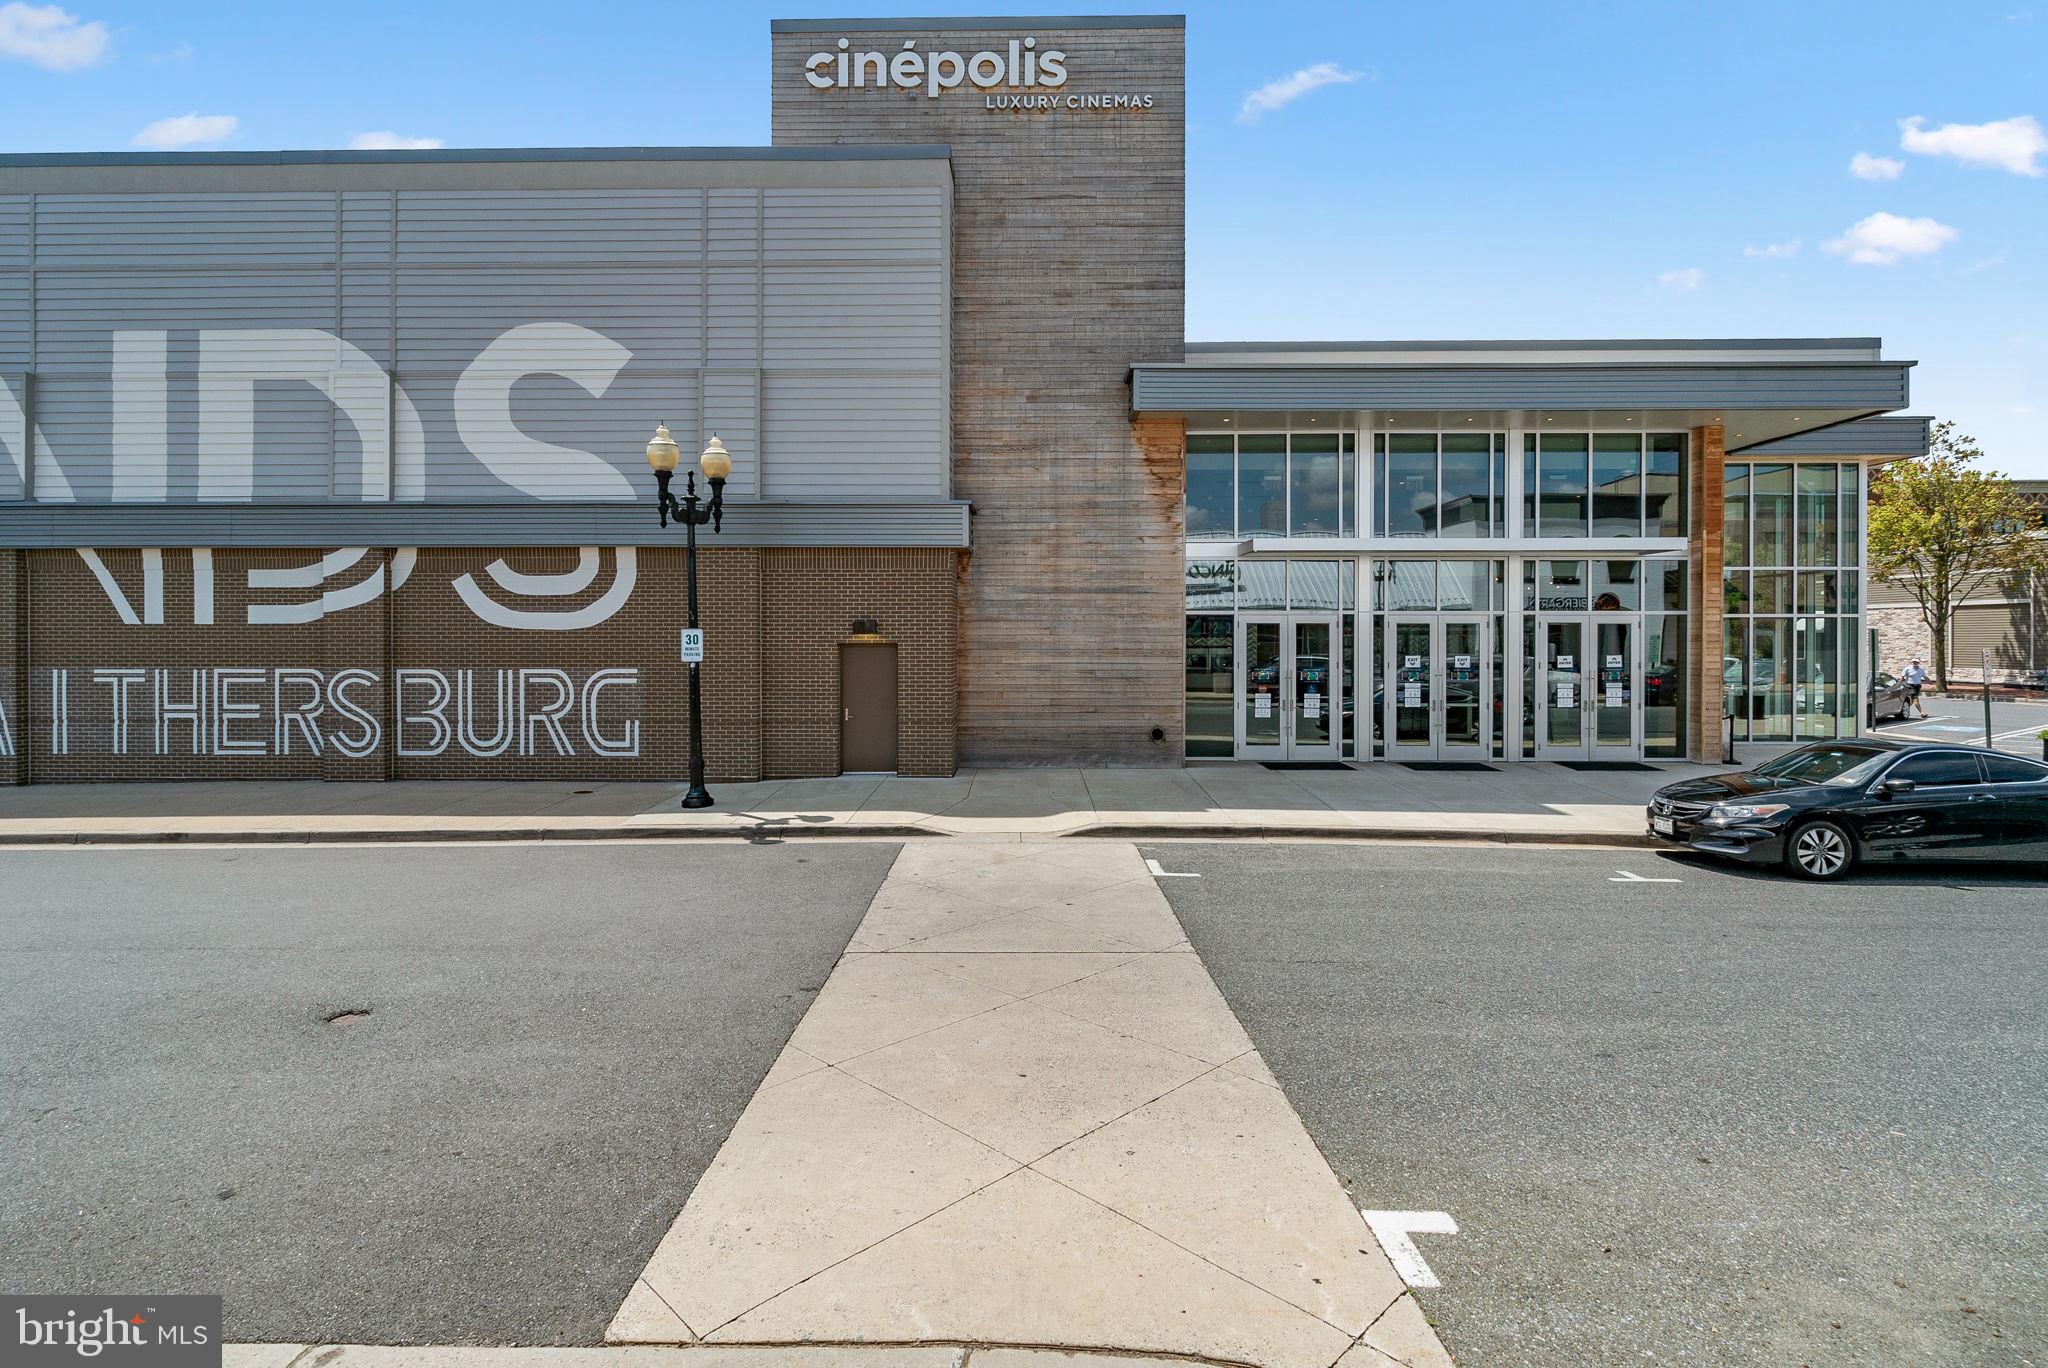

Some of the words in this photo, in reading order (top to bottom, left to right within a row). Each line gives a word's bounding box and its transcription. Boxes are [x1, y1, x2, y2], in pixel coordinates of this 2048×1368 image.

[804, 36, 1069, 99] cinépolis
[986, 95, 1061, 109] LUXURY
[1066, 94, 1154, 109] CINEMAS
[685, 634, 699, 645] 30
[0, 667, 639, 758] ITHERSBURG
